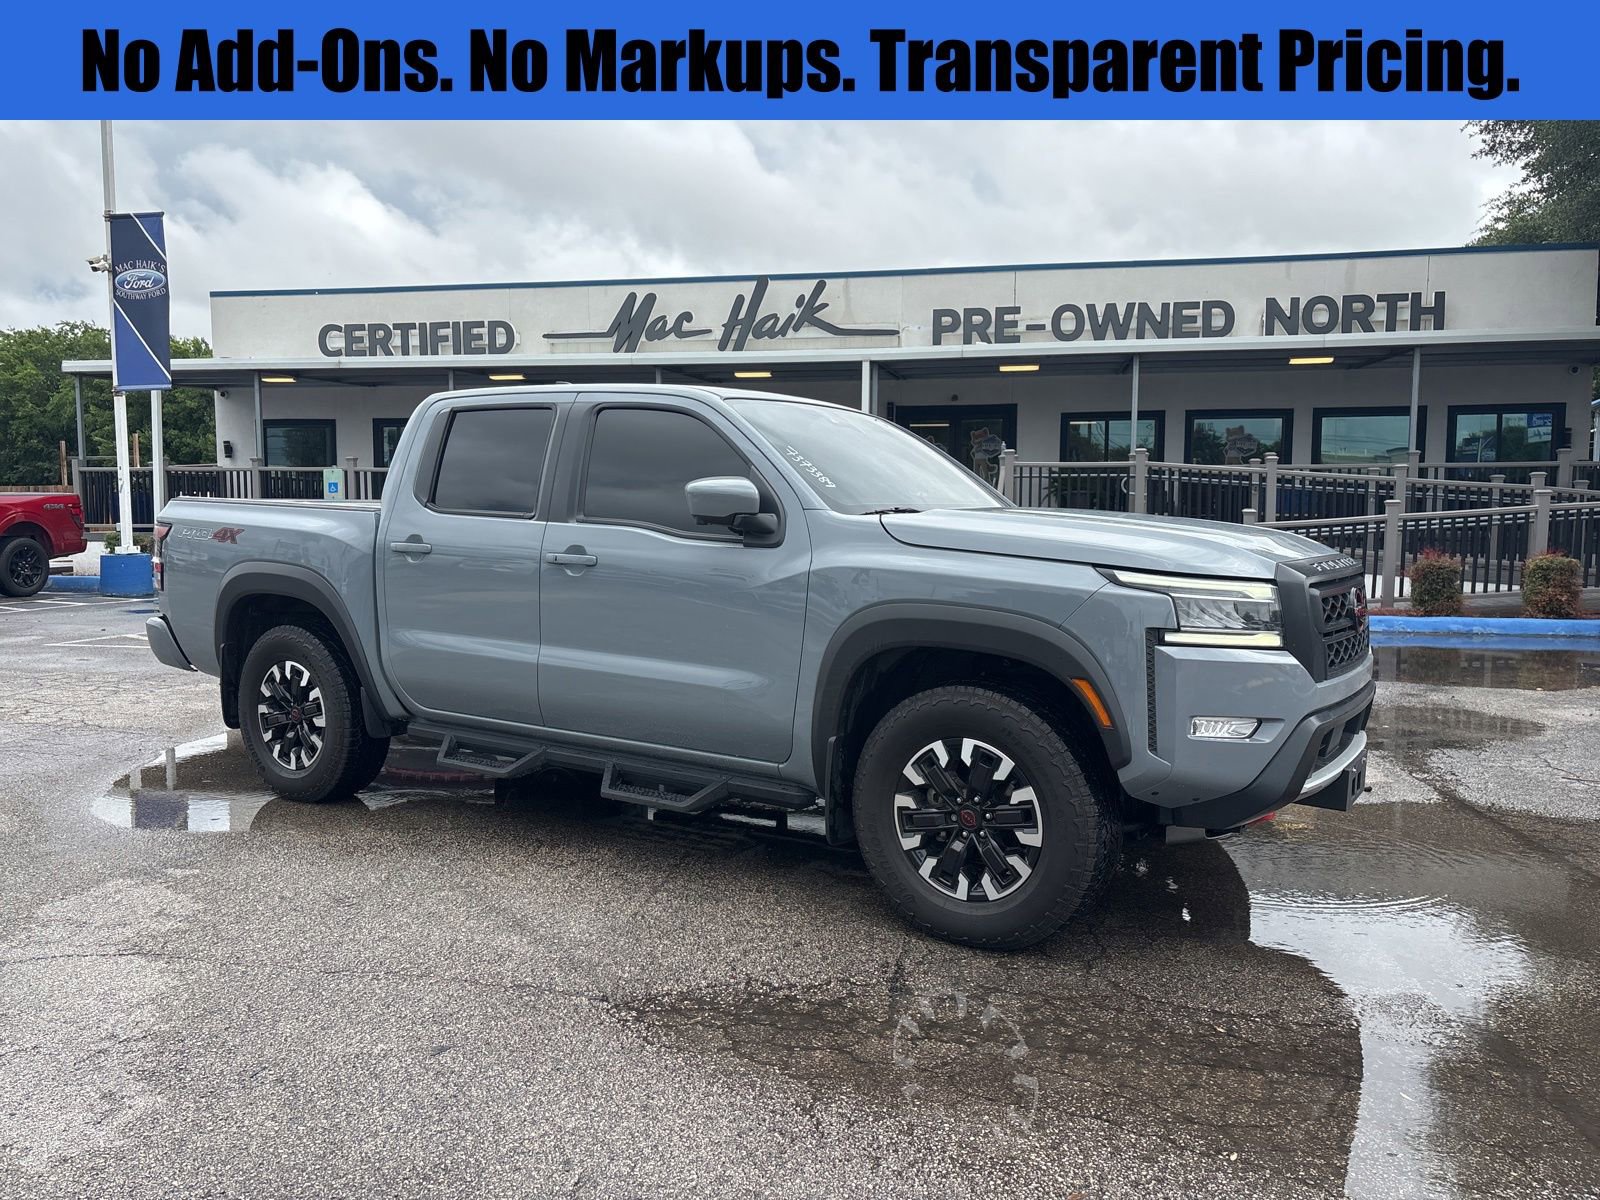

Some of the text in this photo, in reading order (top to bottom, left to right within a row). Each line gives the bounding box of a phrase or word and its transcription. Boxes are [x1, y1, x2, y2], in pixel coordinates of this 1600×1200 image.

[115, 259, 166, 274] MAC HAIK'S
[115, 287, 166, 300] SOUTHWAY FORD
[124, 272, 155, 289] Ford
[542, 275, 901, 353] Mac Haik
[931, 291, 1447, 346] PRE-OWNED NORTH
[318, 320, 516, 357] CERTIFIED
